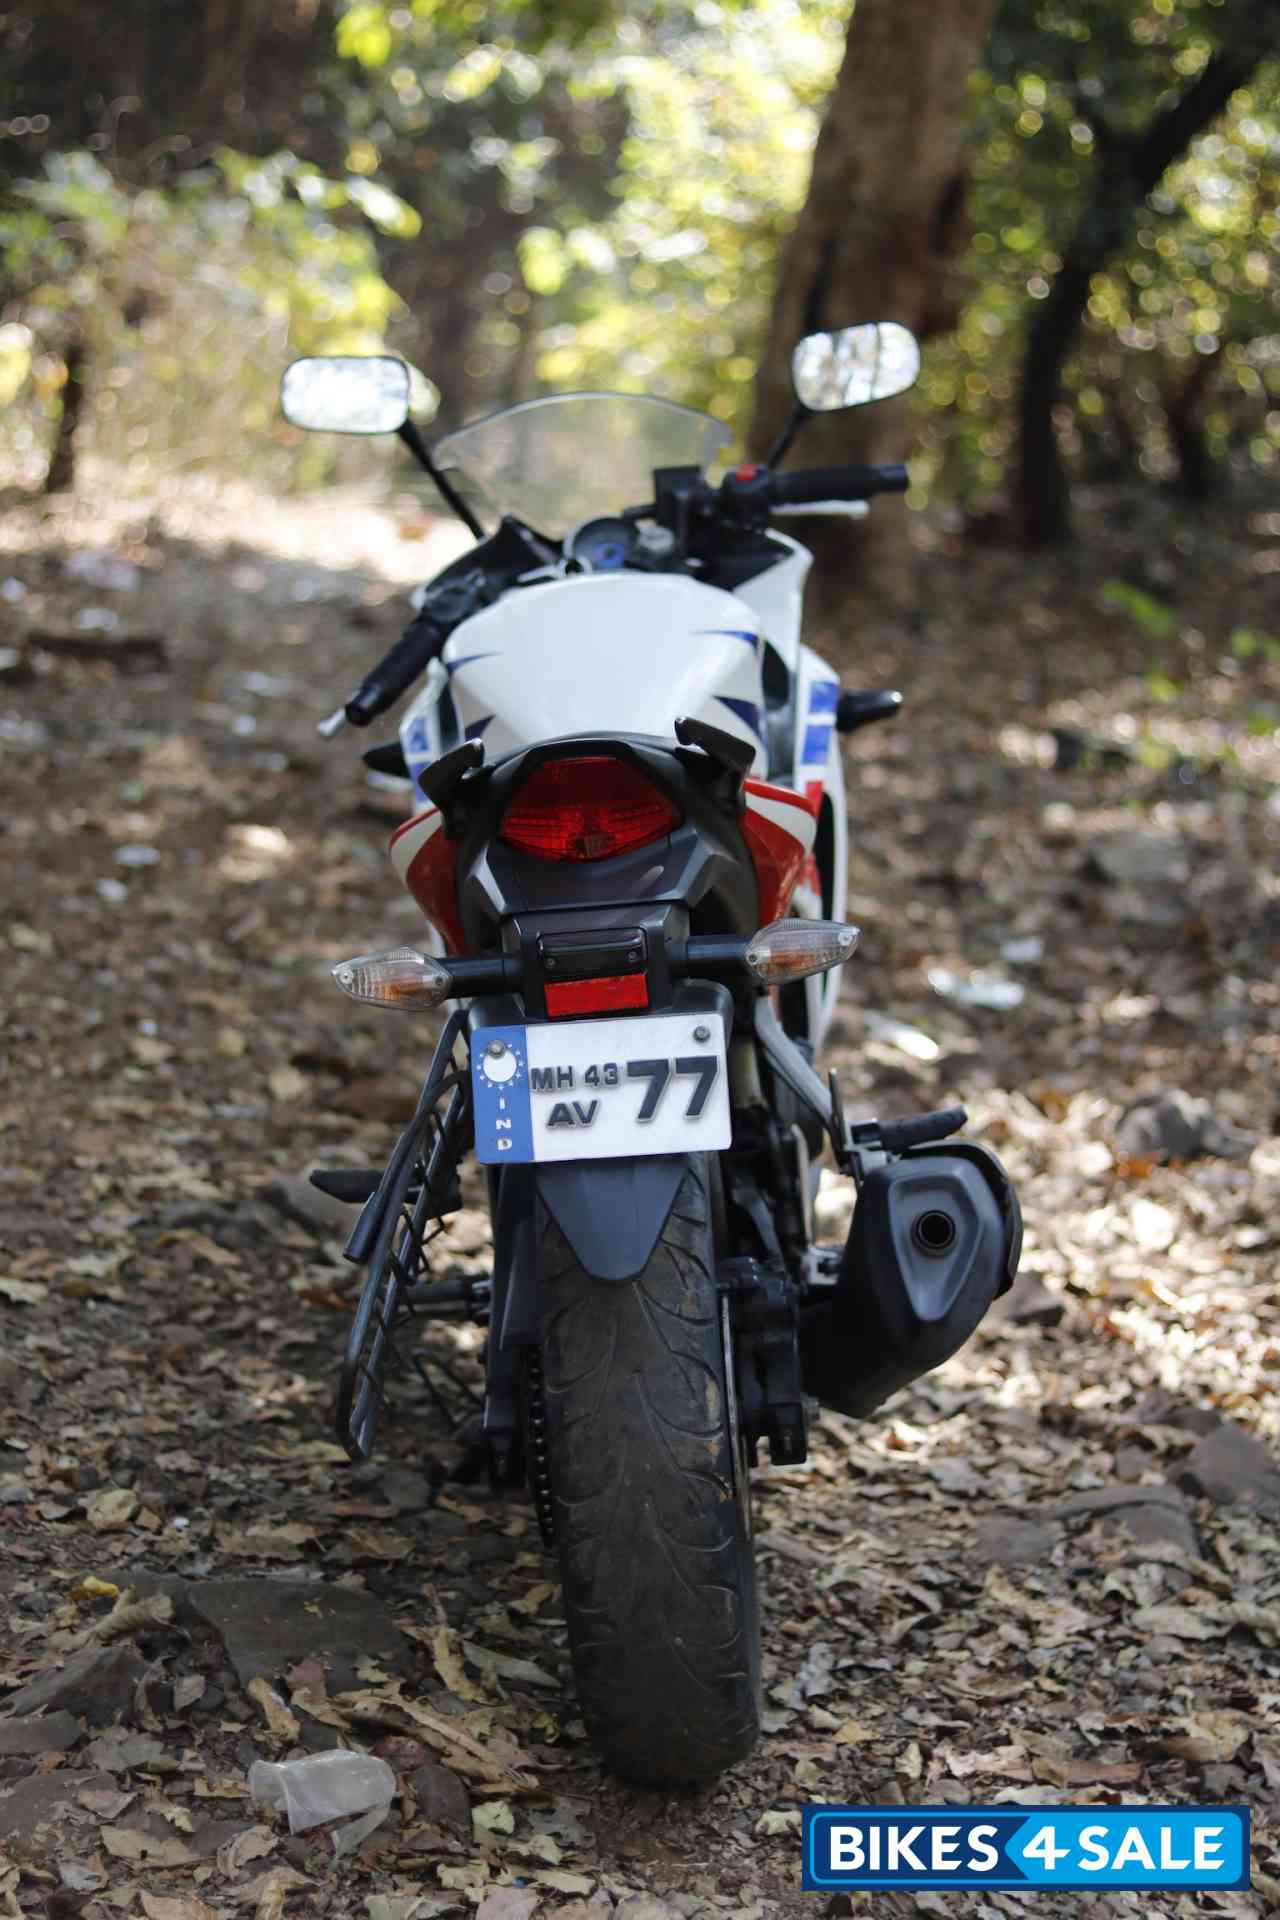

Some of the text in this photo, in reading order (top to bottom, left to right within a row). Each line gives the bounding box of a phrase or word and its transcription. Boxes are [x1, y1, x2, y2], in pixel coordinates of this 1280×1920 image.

[531, 1062, 619, 1091] MH 43
[626, 1055, 719, 1121] 77
[495, 1096, 513, 1151] IND
[546, 1099, 599, 1128] AV
